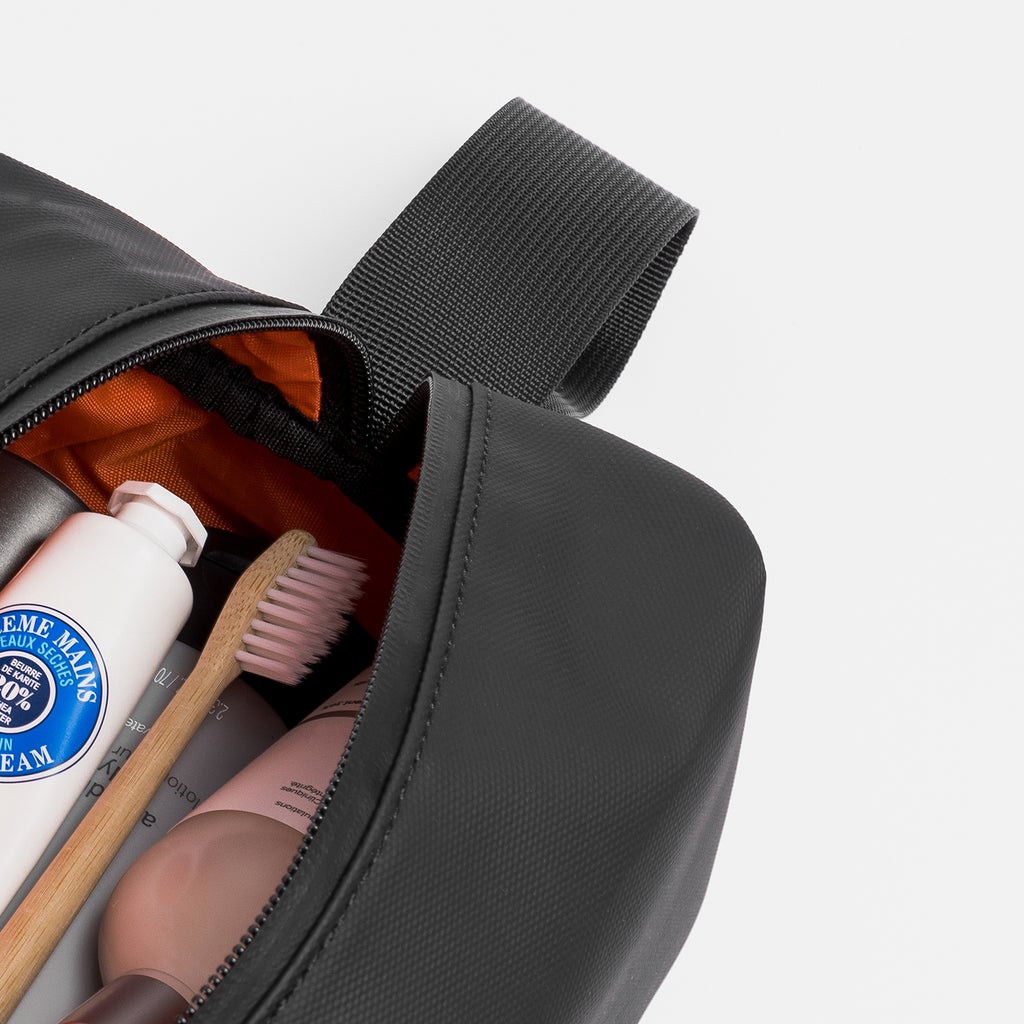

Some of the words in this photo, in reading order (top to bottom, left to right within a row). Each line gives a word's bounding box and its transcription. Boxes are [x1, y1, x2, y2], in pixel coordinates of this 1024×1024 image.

[1, 664, 14, 676] DE
[12, 670, 41, 691] KARITE
[10, 658, 42, 680] BEURRE
[37, 642, 74, 687] SECHES
[52, 629, 97, 703] MAINS
